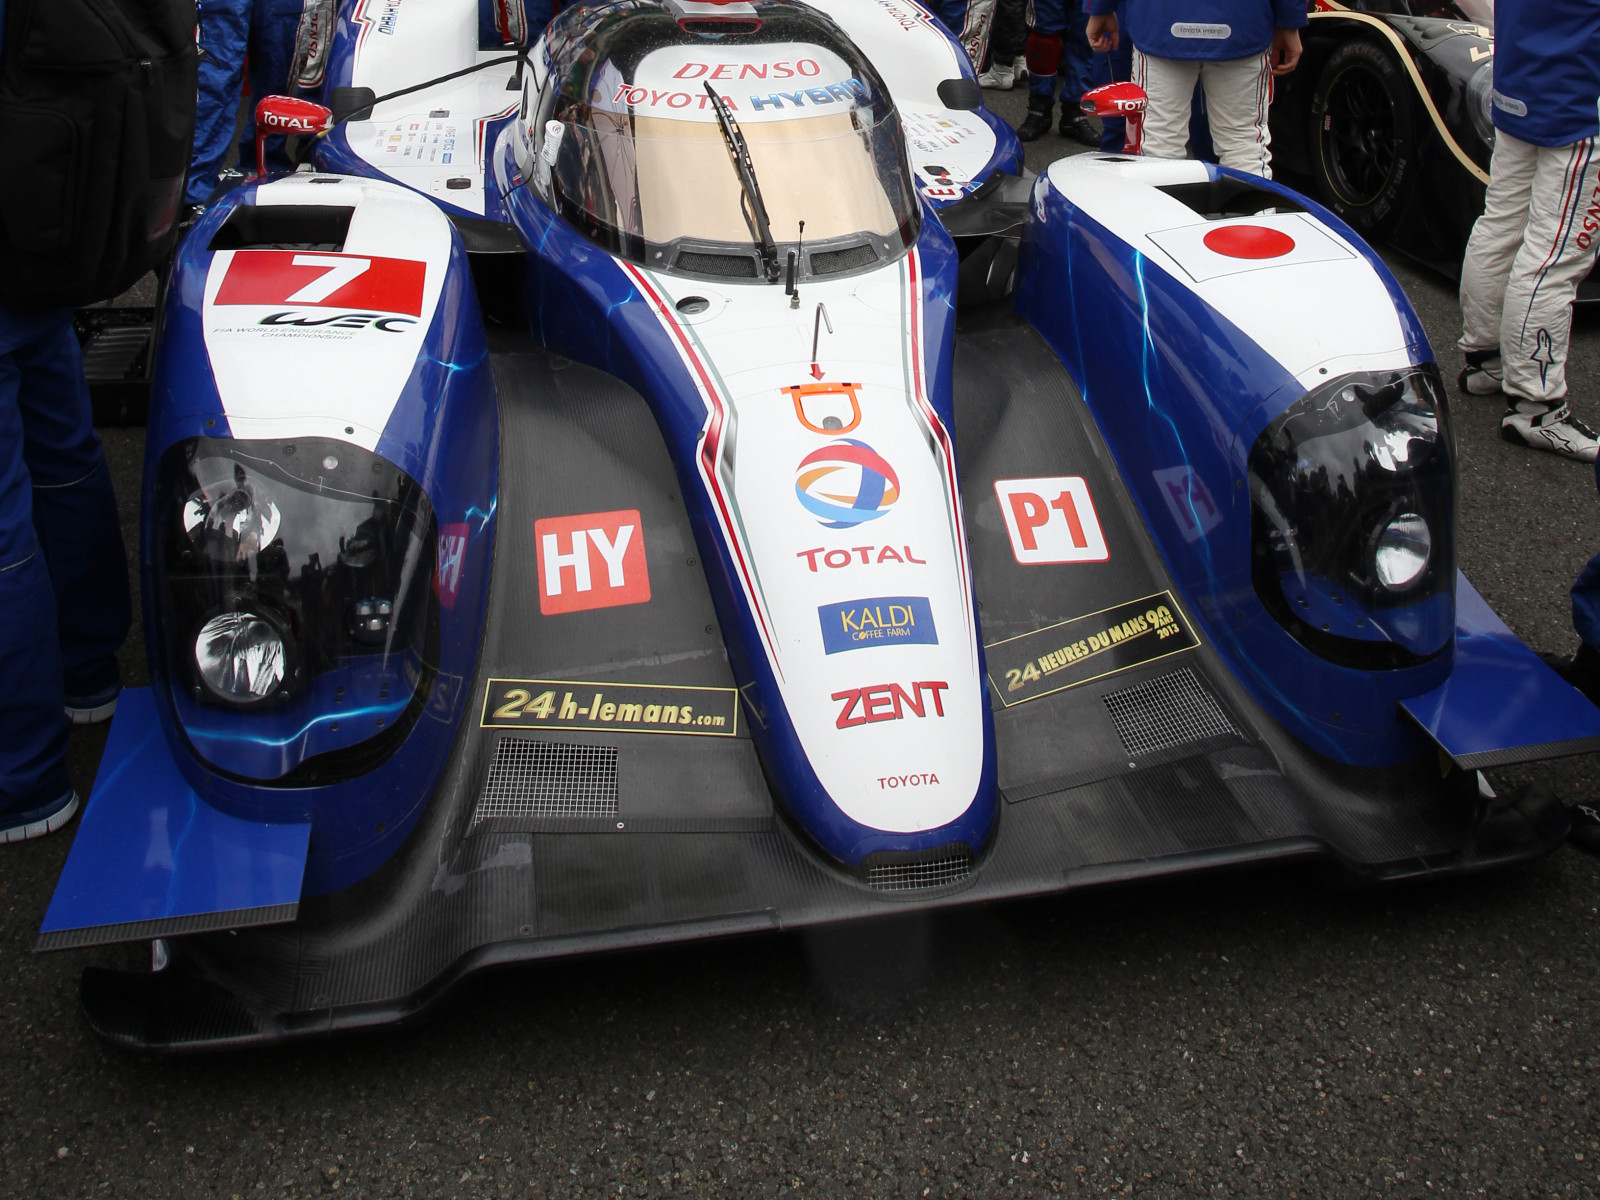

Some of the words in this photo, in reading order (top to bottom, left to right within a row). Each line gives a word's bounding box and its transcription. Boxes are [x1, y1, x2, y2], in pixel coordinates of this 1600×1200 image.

[968, 13, 987, 59] DENSO
[672, 58, 821, 80] DENSO
[612, 83, 739, 111] TOYOTA
[750, 77, 868, 111] HYBRID
[264, 110, 314, 129] TOTAL
[284, 254, 372, 304] 7
[257, 311, 418, 333] WEC
[280, 327, 356, 337] ENDURANCE
[261, 332, 353, 340] CHAMPIONSHIP
[1007, 490, 1089, 551] P1
[542, 524, 635, 597] HY
[796, 545, 927, 573] TOTAL
[841, 605, 916, 632] KALDI
[1157, 623, 1180, 639] 2013
[852, 628, 884, 641] COFFEE
[887, 628, 911, 638] FARM
[1005, 661, 1041, 692] 24
[1037, 638, 1090, 673] HEURES
[1087, 630, 1111, 652] DU
[1108, 615, 1149, 644] MANS
[831, 681, 949, 730] ZENT
[877, 773, 940, 789] TOYOTA
